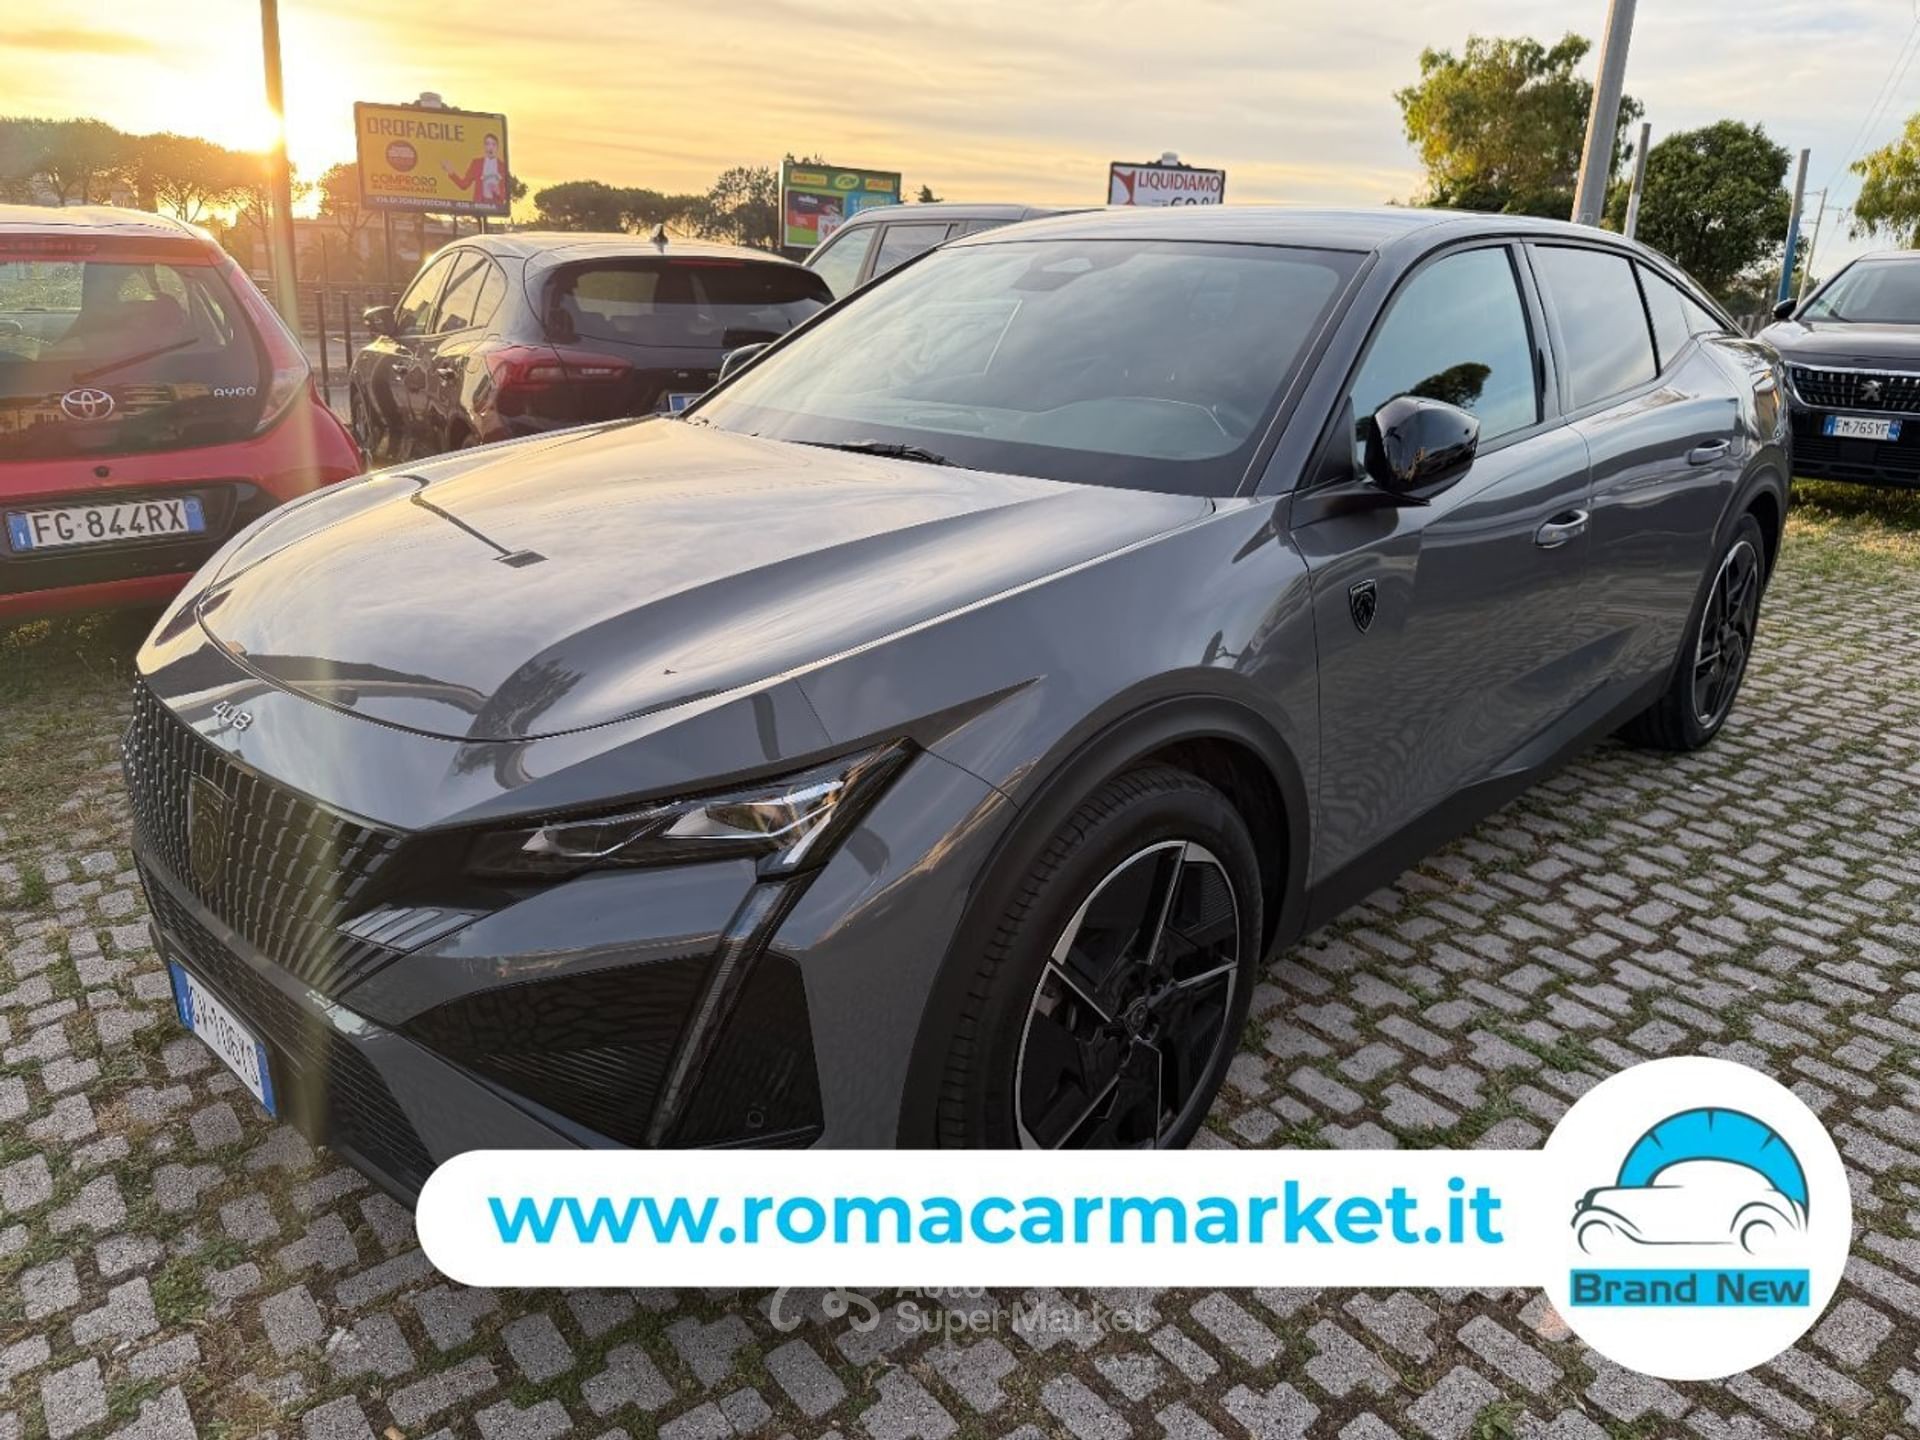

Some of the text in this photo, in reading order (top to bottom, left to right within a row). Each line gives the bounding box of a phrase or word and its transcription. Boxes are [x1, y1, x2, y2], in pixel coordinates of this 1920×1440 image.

[367, 117, 465, 142] OROFACILE
[1138, 171, 1221, 192] LIQUIDIAMO
[213, 386, 257, 398] AYGO
[213, 701, 252, 730] 408
